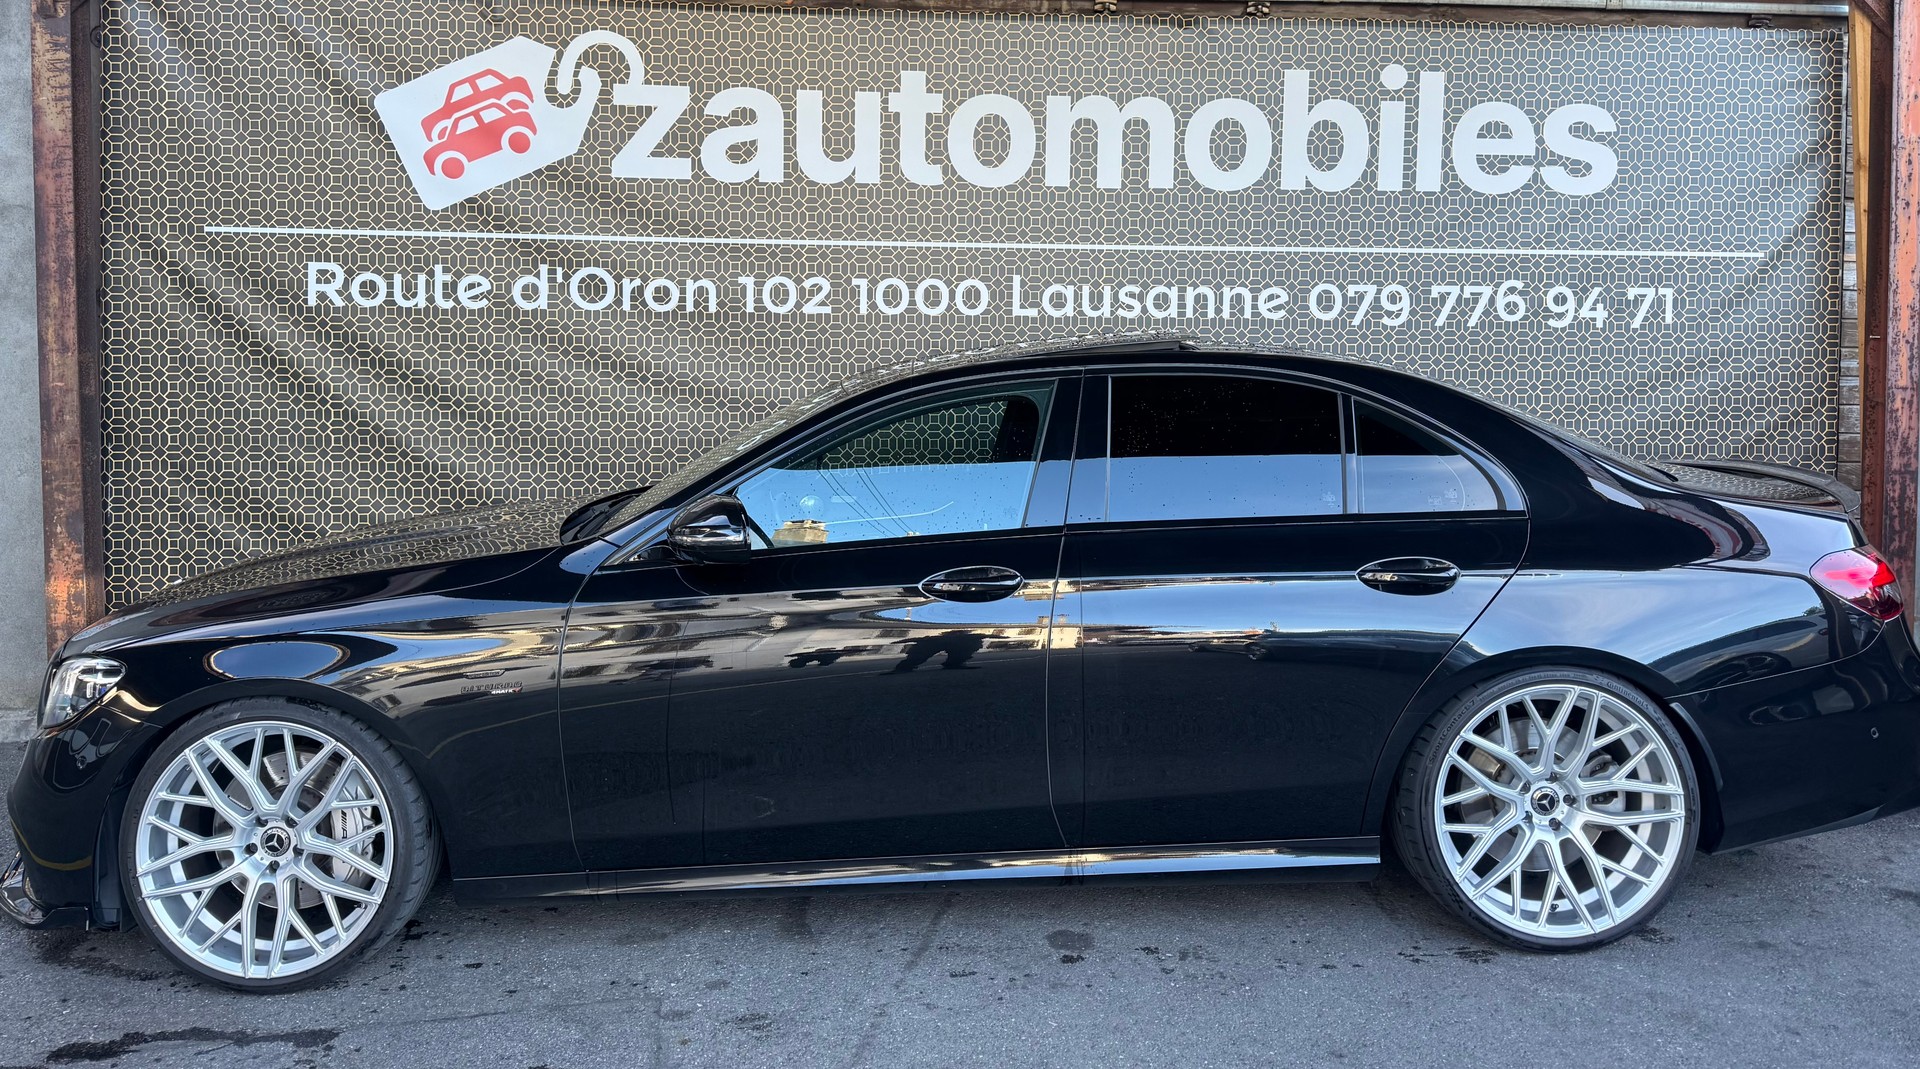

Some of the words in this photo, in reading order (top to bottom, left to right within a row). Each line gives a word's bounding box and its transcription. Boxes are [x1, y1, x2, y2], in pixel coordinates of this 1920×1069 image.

[610, 63, 1620, 197] zautomobiles
[306, 260, 490, 312] Route
[510, 263, 719, 315] d'Oron
[737, 275, 833, 316] 102
[851, 276, 990, 318] 1000
[1011, 273, 1290, 322] Lausanne
[1308, 283, 1412, 328] 079
[1430, 278, 1527, 329] 776
[1545, 284, 1610, 329] 94
[1626, 286, 1675, 330] 71
